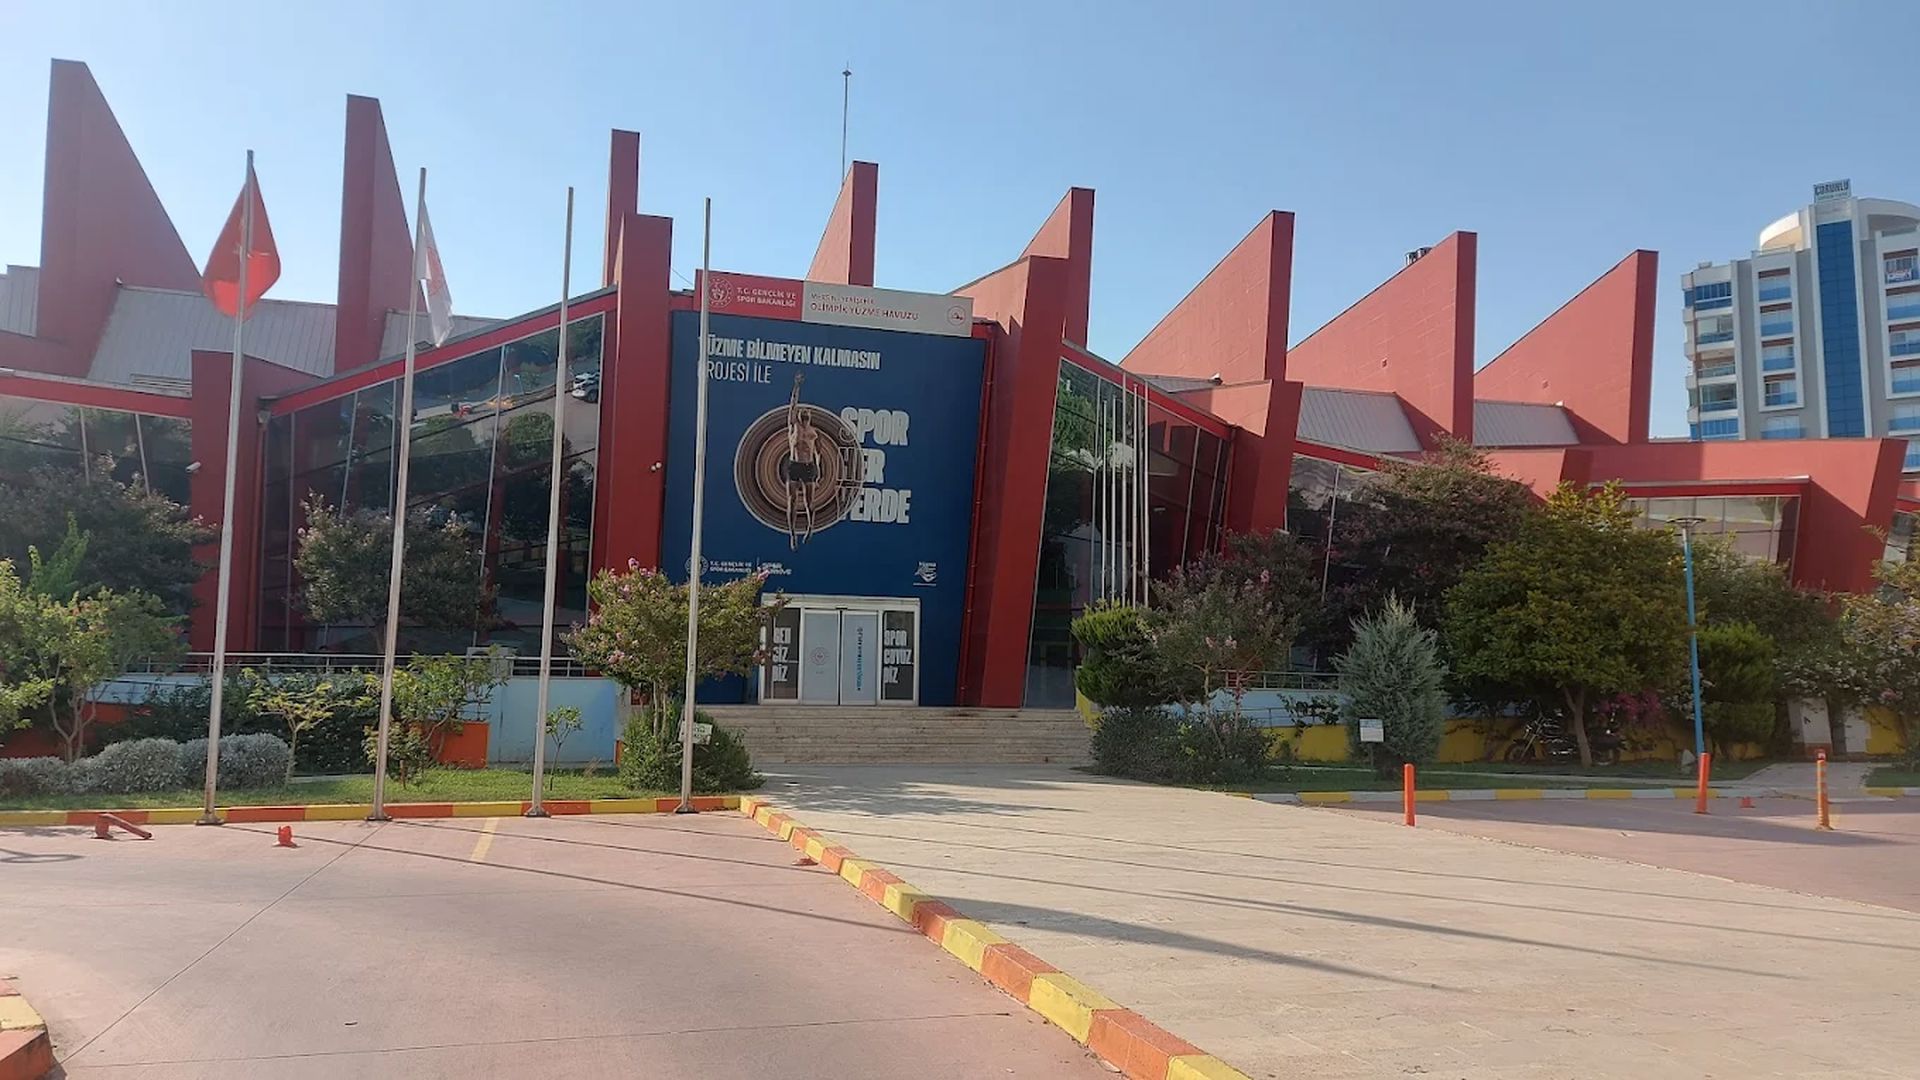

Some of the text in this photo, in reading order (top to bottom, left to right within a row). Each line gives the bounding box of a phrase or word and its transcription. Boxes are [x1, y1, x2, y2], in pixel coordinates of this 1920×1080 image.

[736, 295, 756, 304] SPOR
[786, 291, 797, 300] VE
[811, 301, 848, 314] OLİMPİK
[882, 308, 919, 321] HAVUZU
[698, 333, 881, 370] ÜZME BİLMEYEN KALMASIN
[700, 360, 772, 384] ROJESİ İLE
[839, 406, 910, 446] SPOR
[883, 629, 907, 646] SPOR
